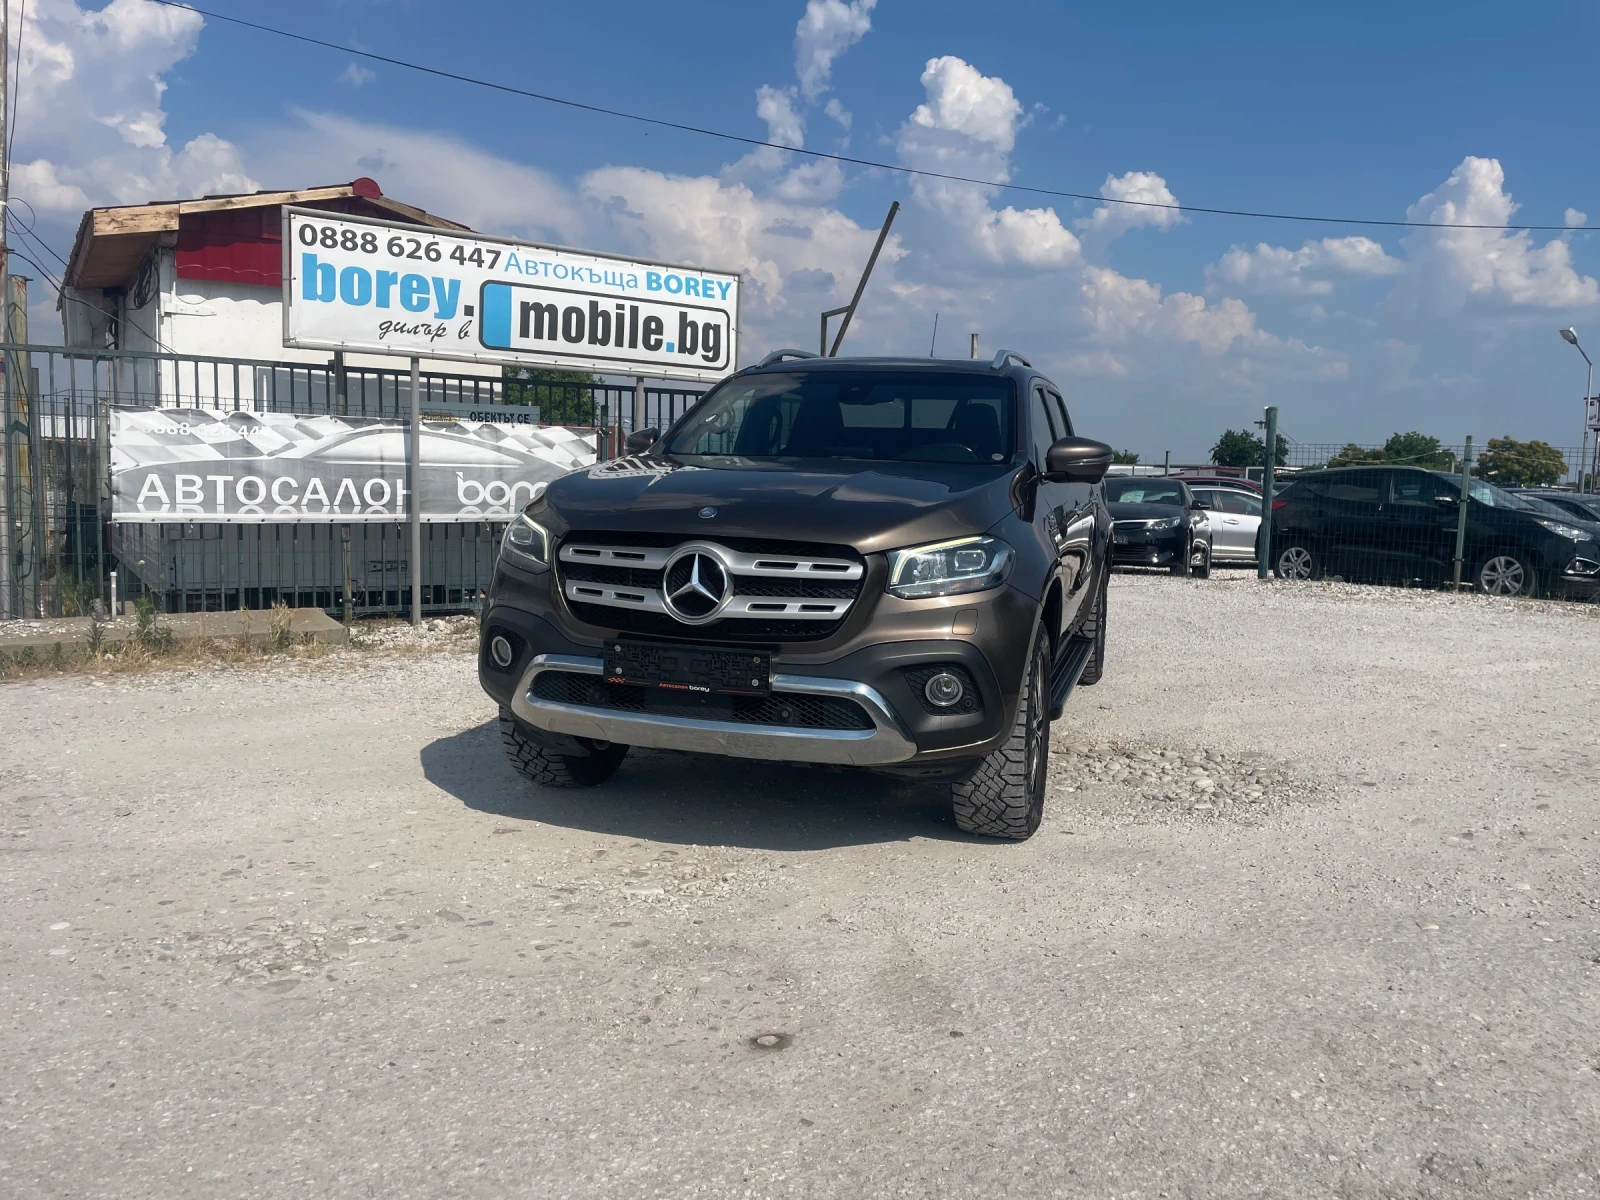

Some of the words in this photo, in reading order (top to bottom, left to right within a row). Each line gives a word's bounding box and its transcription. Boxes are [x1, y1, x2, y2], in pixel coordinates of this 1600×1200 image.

[299, 223, 379, 254] 0888
[386, 236, 442, 263] 626
[449, 244, 502, 270] 447
[504, 252, 638, 291] Автокъща
[646, 271, 732, 301] BOREY
[378, 320, 448, 343] дилър
[457, 319, 473, 340] в
[519, 299, 721, 363] mobile.bg
[517, 413, 531, 424] СЕ
